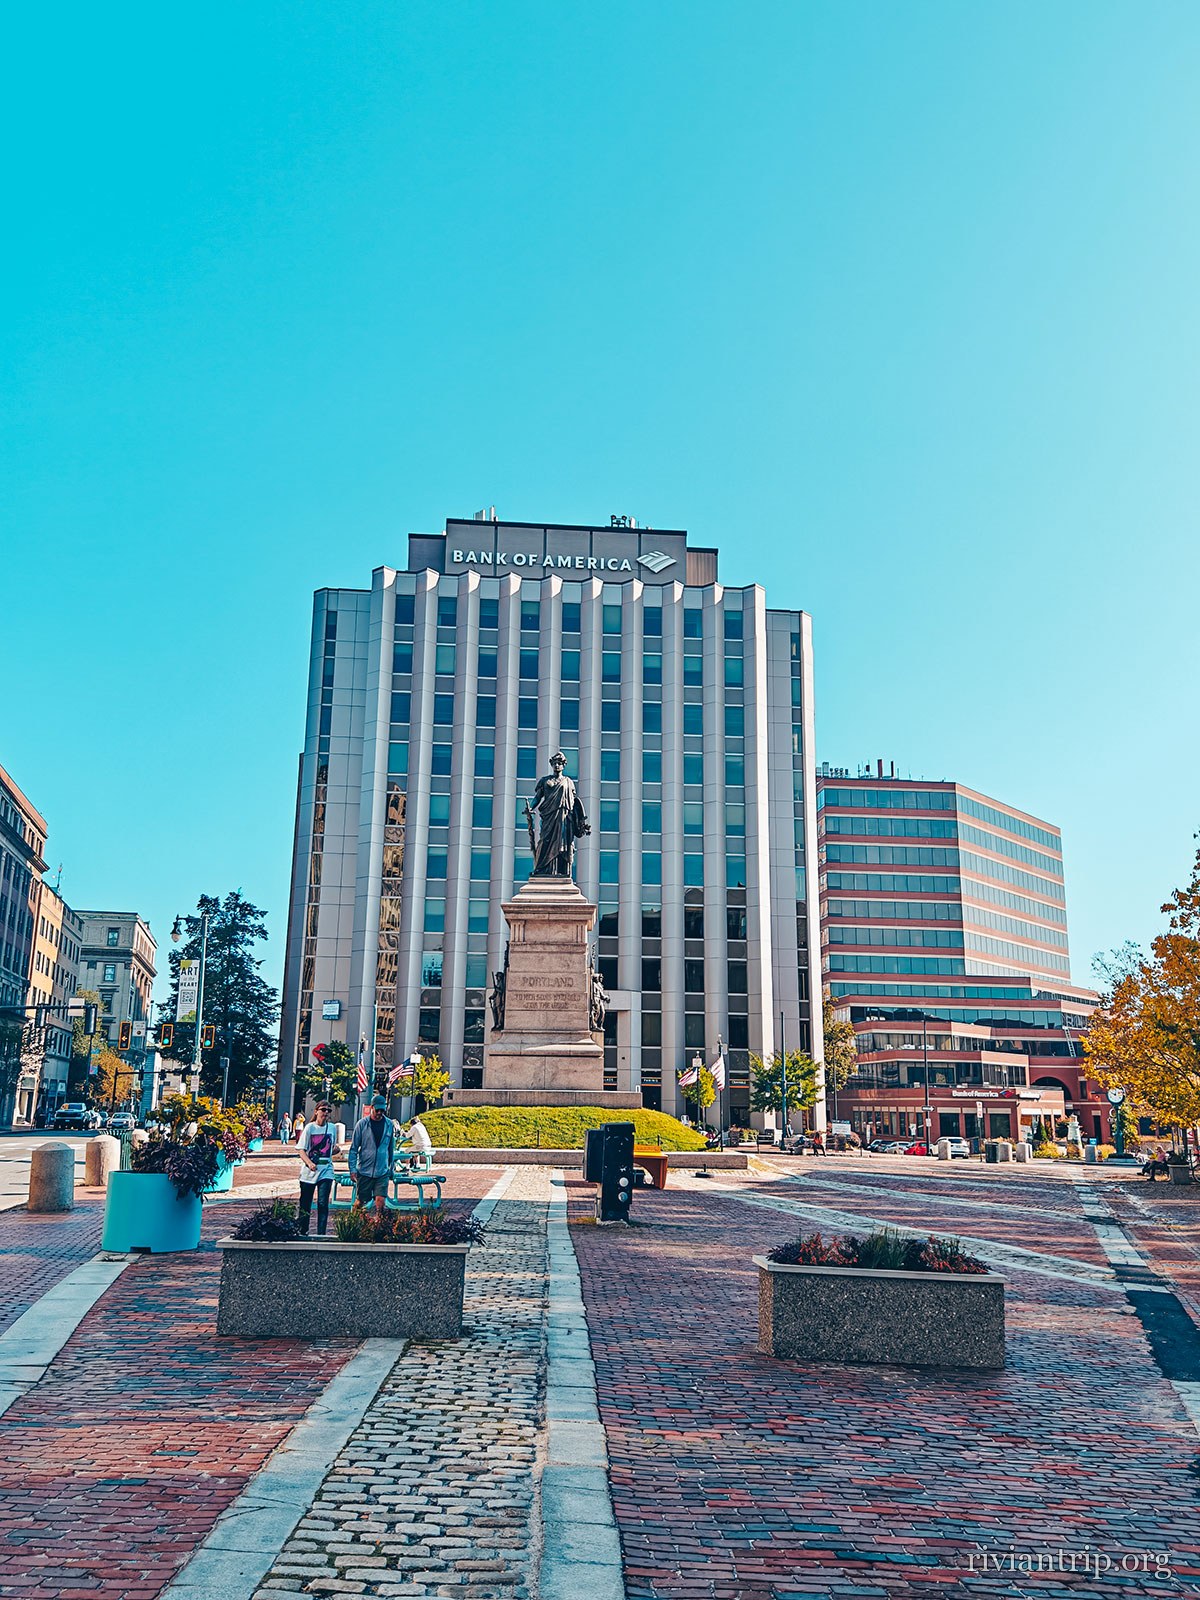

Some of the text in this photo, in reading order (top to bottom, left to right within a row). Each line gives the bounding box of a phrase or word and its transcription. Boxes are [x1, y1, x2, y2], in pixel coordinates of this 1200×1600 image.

[453, 550, 632, 571] BANK OF AMERICA
[181, 967, 198, 975] ART
[521, 976, 574, 988] PORTLAND
